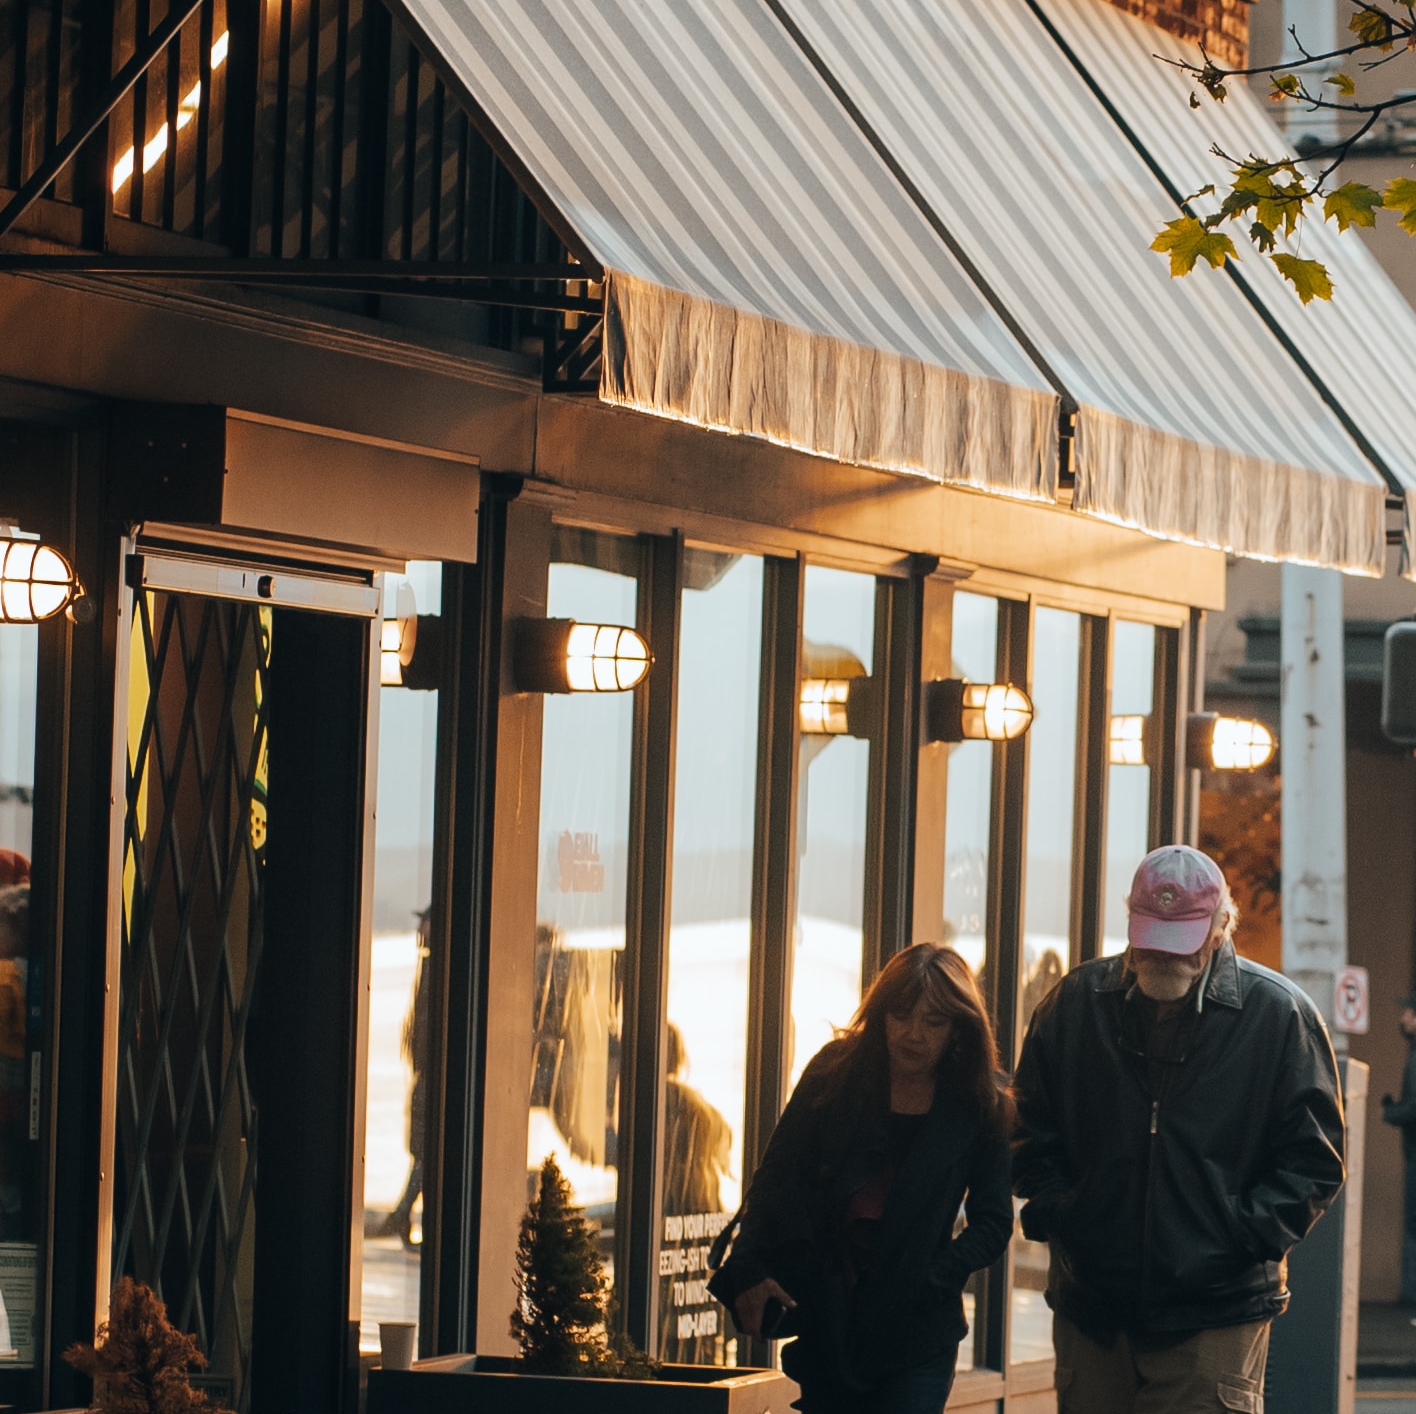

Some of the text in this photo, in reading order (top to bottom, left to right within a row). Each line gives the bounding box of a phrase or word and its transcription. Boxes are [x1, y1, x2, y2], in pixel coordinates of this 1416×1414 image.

[664, 1211, 736, 1241] FIND YOUR PERFE
[659, 1246, 700, 1276] EEZING-ISH
[673, 1281, 685, 1307] TO
[677, 1310, 718, 1340] MID-LAYER
